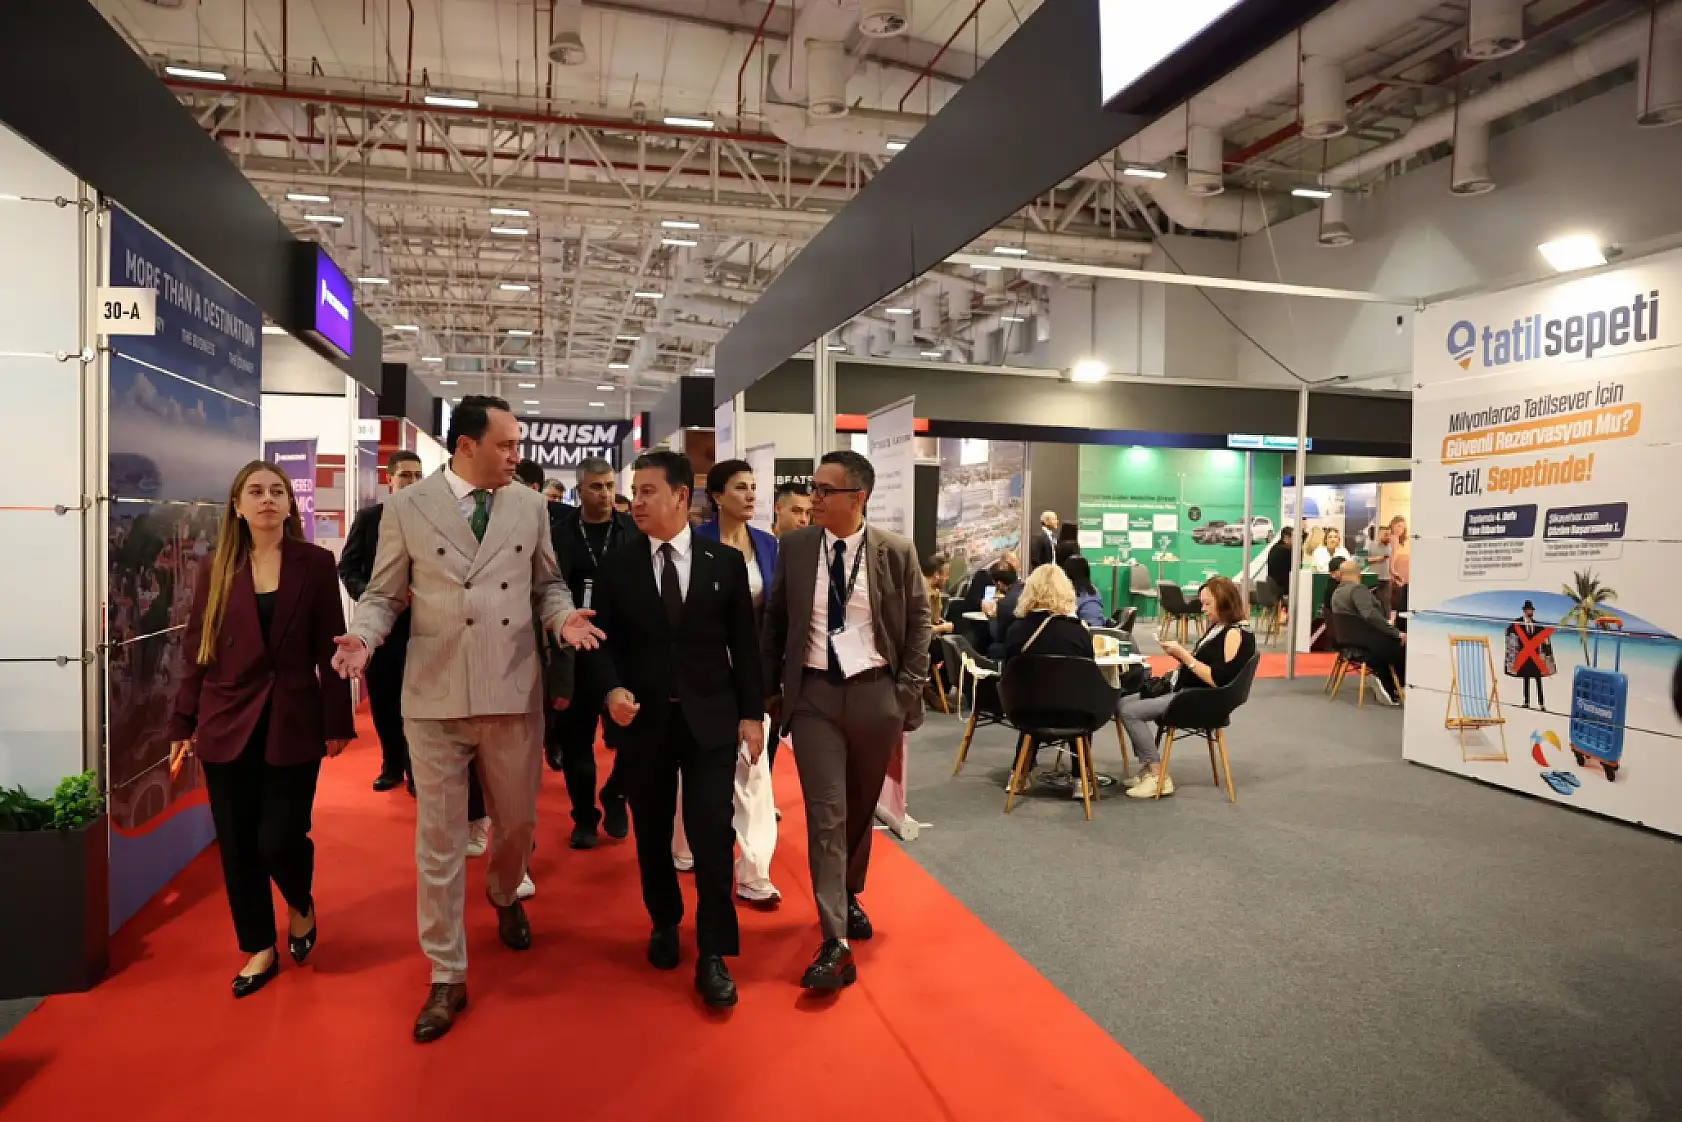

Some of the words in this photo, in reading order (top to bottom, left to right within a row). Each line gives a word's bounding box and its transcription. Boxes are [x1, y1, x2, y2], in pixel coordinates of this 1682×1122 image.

[103, 301, 141, 320] 30-A
[125, 249, 161, 297] MORE
[163, 273, 193, 315] THAN
[194, 292, 202, 319] A
[203, 297, 256, 349] DESTINATION
[1482, 288, 1660, 367] tatilsepeti
[1449, 403, 1521, 433] Milyonlarca
[1524, 389, 1592, 419] Tatilsever
[1595, 380, 1624, 408] İçin
[517, 421, 618, 444] OURISM
[1447, 431, 1495, 459] Güvenli
[1496, 418, 1593, 450] Rezervasyon
[518, 443, 603, 467] UMMIT
[1449, 467, 1482, 496] Tatil,
[1487, 452, 1595, 494] Sepetinde!
